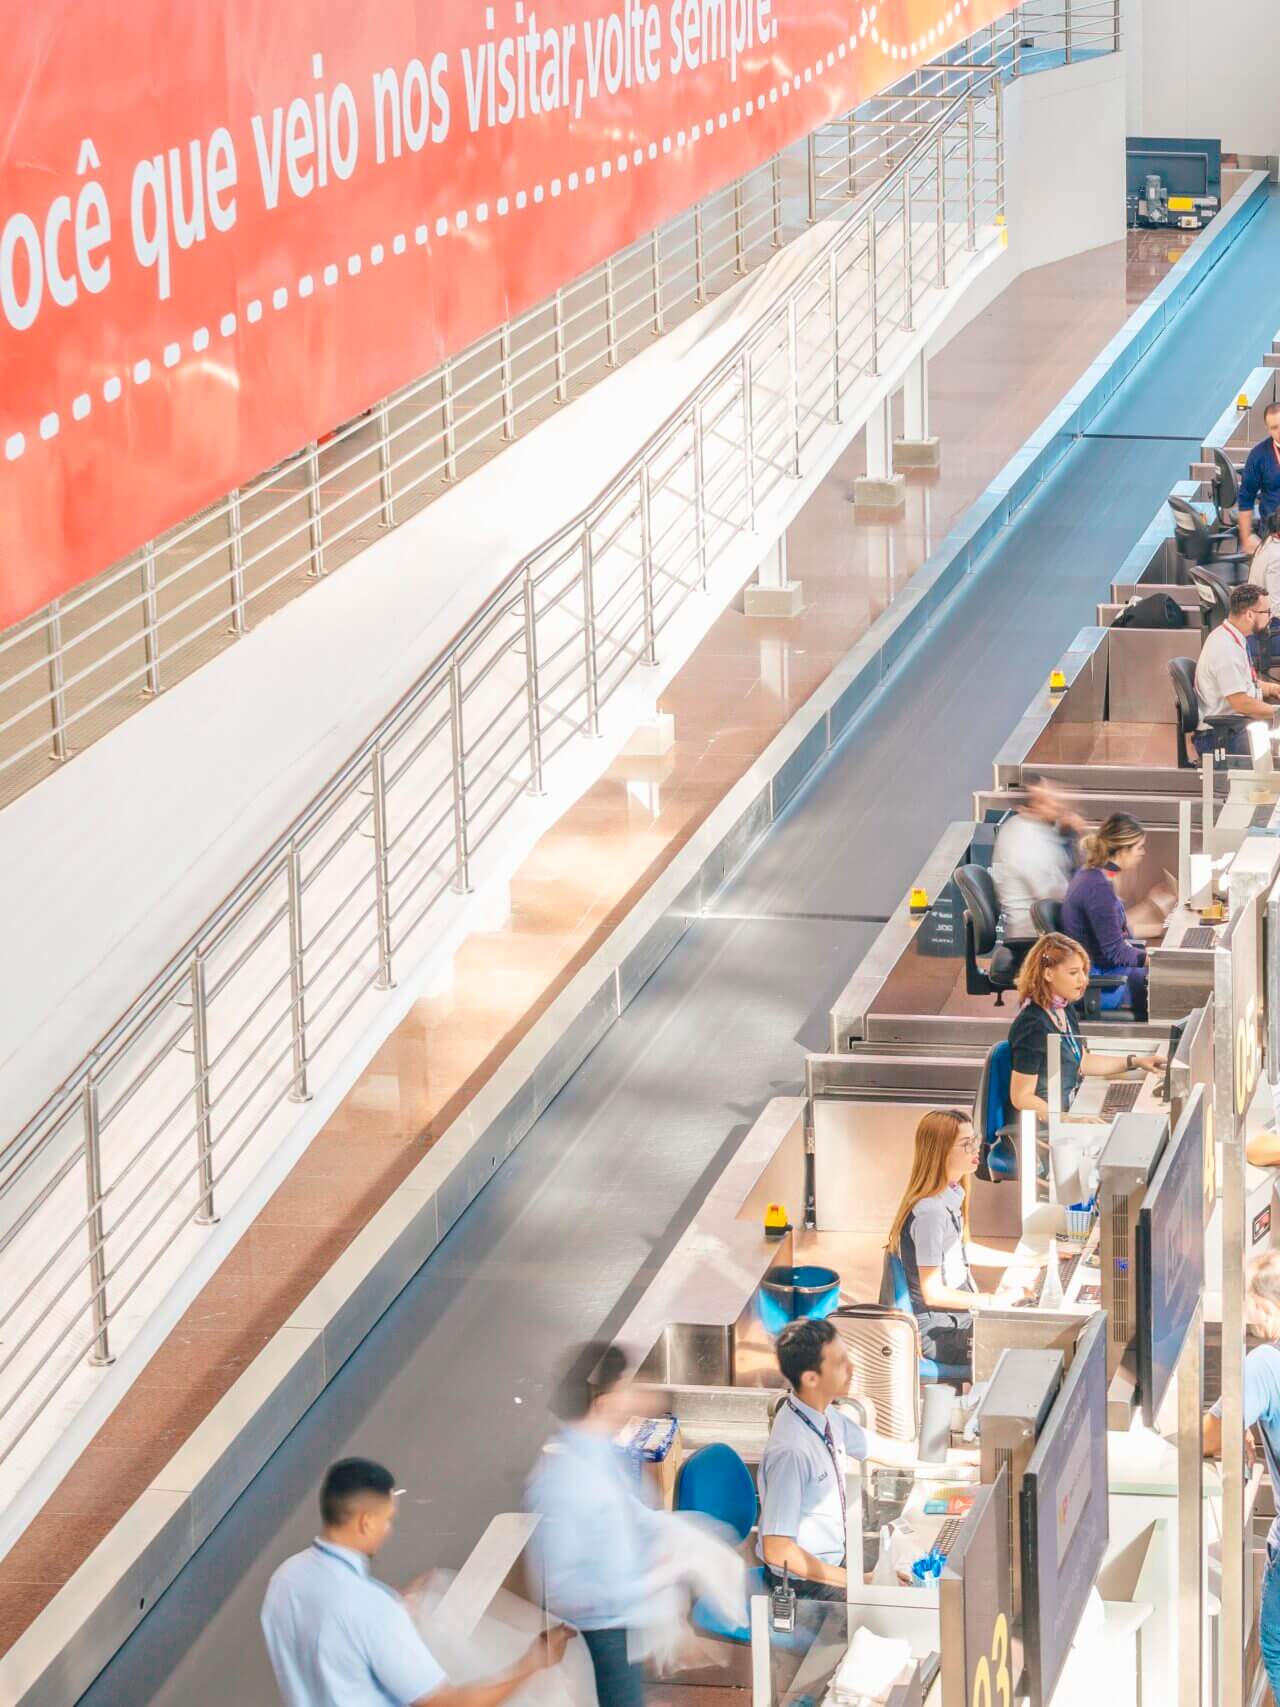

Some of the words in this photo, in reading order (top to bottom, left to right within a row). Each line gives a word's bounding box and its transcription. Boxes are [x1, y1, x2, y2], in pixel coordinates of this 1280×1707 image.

[131, 127, 238, 300] que
[251, 53, 359, 209] veio
[372, 52, 451, 165] nos
[670, 0, 778, 82] sempre.
